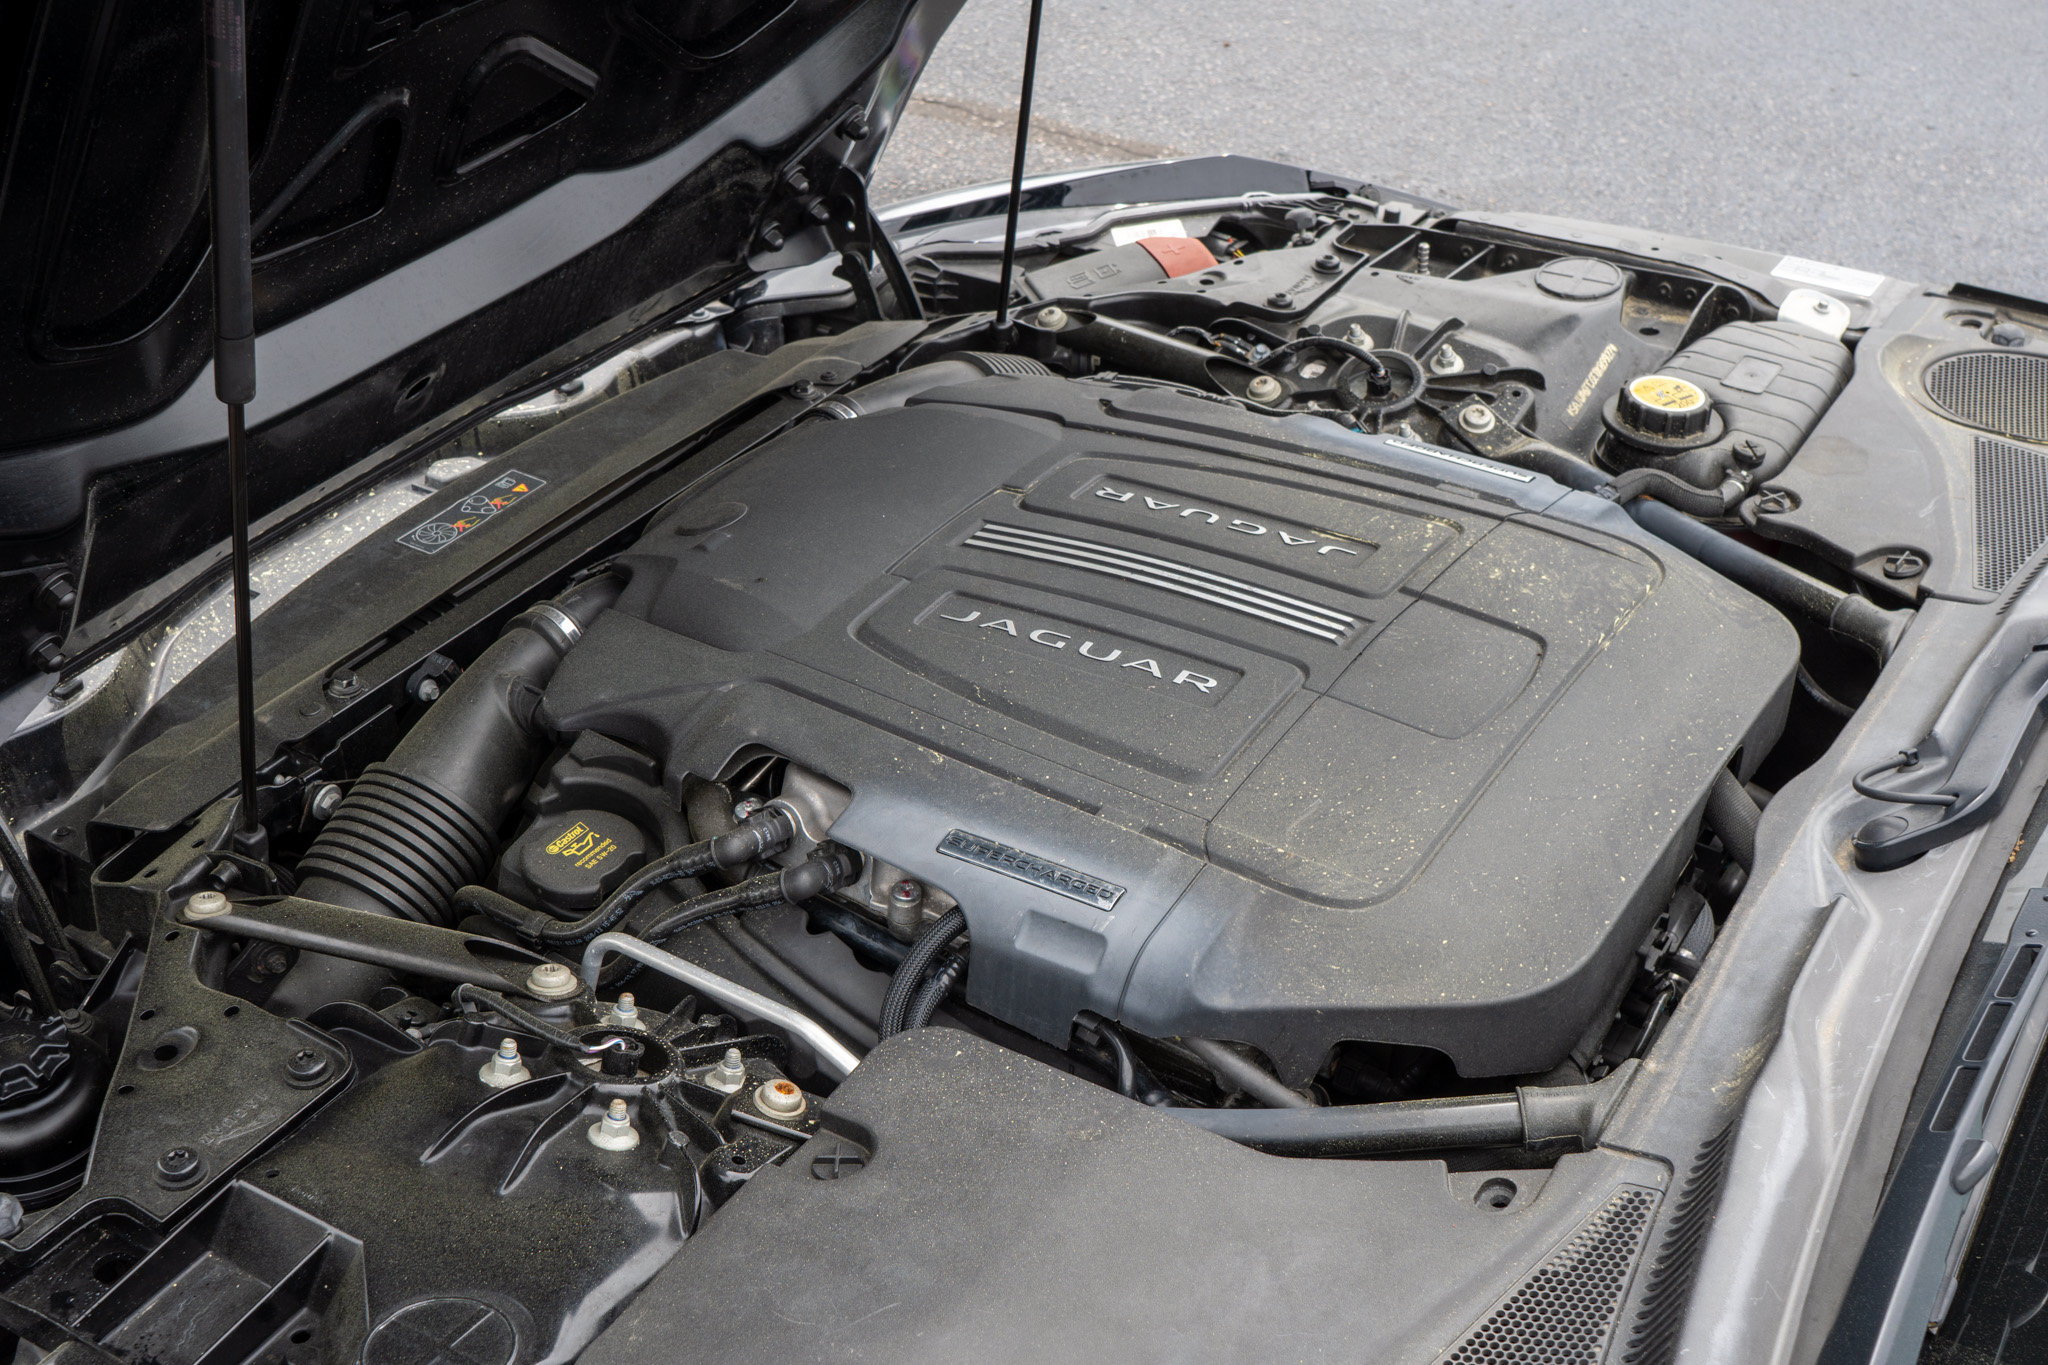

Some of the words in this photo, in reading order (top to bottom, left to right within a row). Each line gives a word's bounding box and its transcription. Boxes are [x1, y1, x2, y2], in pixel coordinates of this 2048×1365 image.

[1094, 484, 1358, 556] JAGUAR
[939, 609, 1219, 695] JAGUAR
[555, 826, 584, 848] Castrol
[574, 838, 613, 868] recommended
[584, 858, 599, 870] SAE
[597, 844, 617, 861] 5W-20
[945, 834, 1114, 901] SUPERCHARGED
